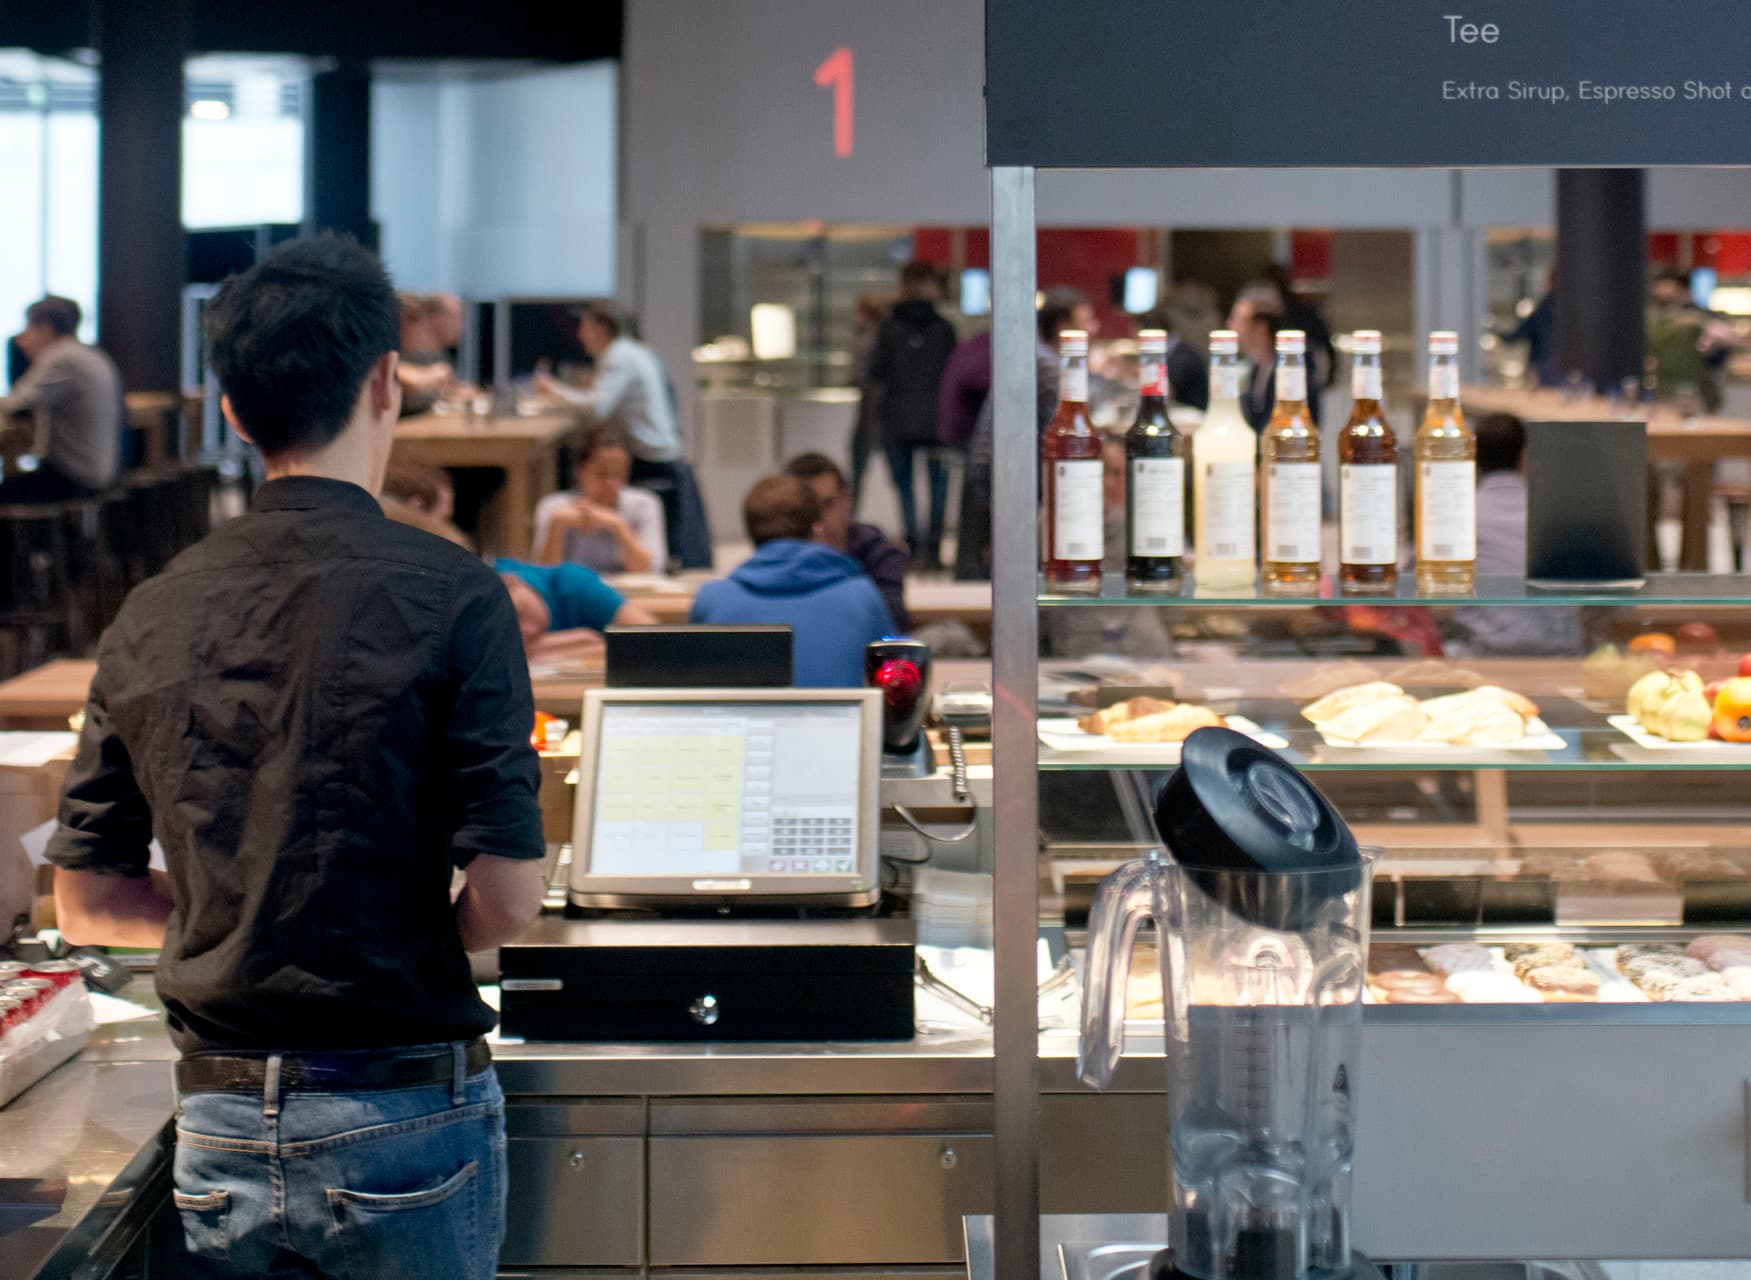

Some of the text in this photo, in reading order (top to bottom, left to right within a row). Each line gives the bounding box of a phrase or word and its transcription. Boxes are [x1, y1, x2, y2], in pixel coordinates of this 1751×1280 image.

[1442, 15, 1500, 44] Tee
[813, 48, 855, 158] 1
[1442, 80, 1500, 100] Extra
[1508, 80, 1570, 105] Sirup,
[1578, 80, 1676, 105] Espresso
[1683, 80, 1732, 100] Shot
